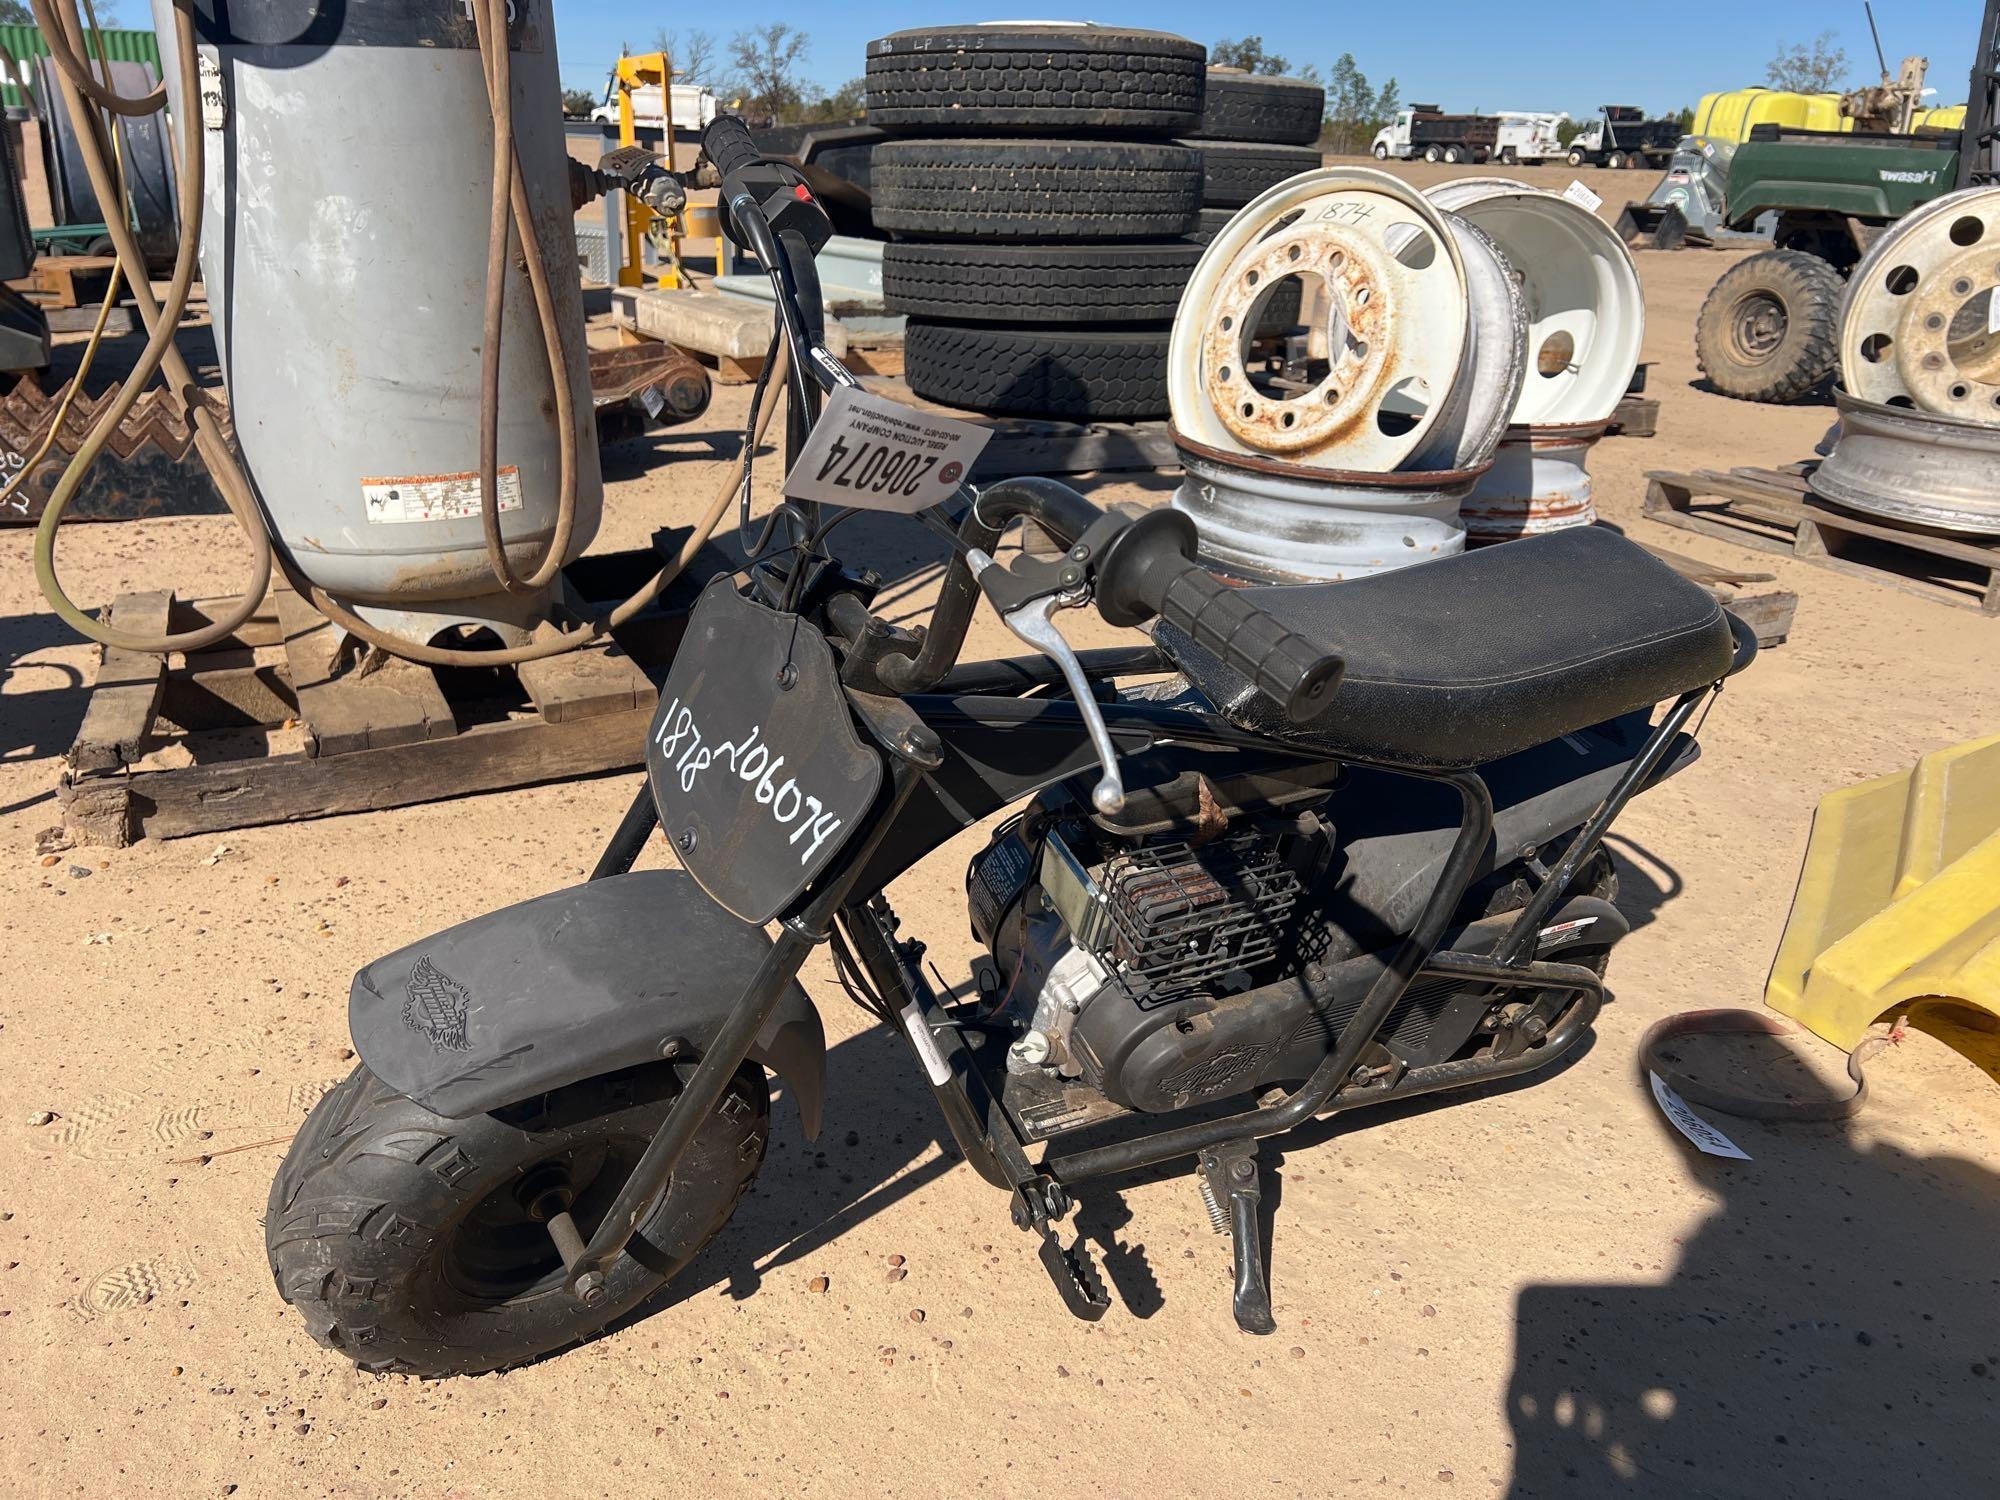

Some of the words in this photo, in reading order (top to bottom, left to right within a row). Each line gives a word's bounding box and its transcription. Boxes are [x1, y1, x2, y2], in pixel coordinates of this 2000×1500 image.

[914, 38, 933, 51] LP
[1314, 202, 1376, 225] 1874
[848, 404, 921, 432] www.rebelauction.net
[848, 419, 892, 439] COMPANY
[892, 432, 926, 447] AUCTION
[927, 440, 948, 451] REBEL
[816, 435, 938, 496] 206074
[655, 698, 711, 792] 1878
[713, 726, 842, 866] 206074
